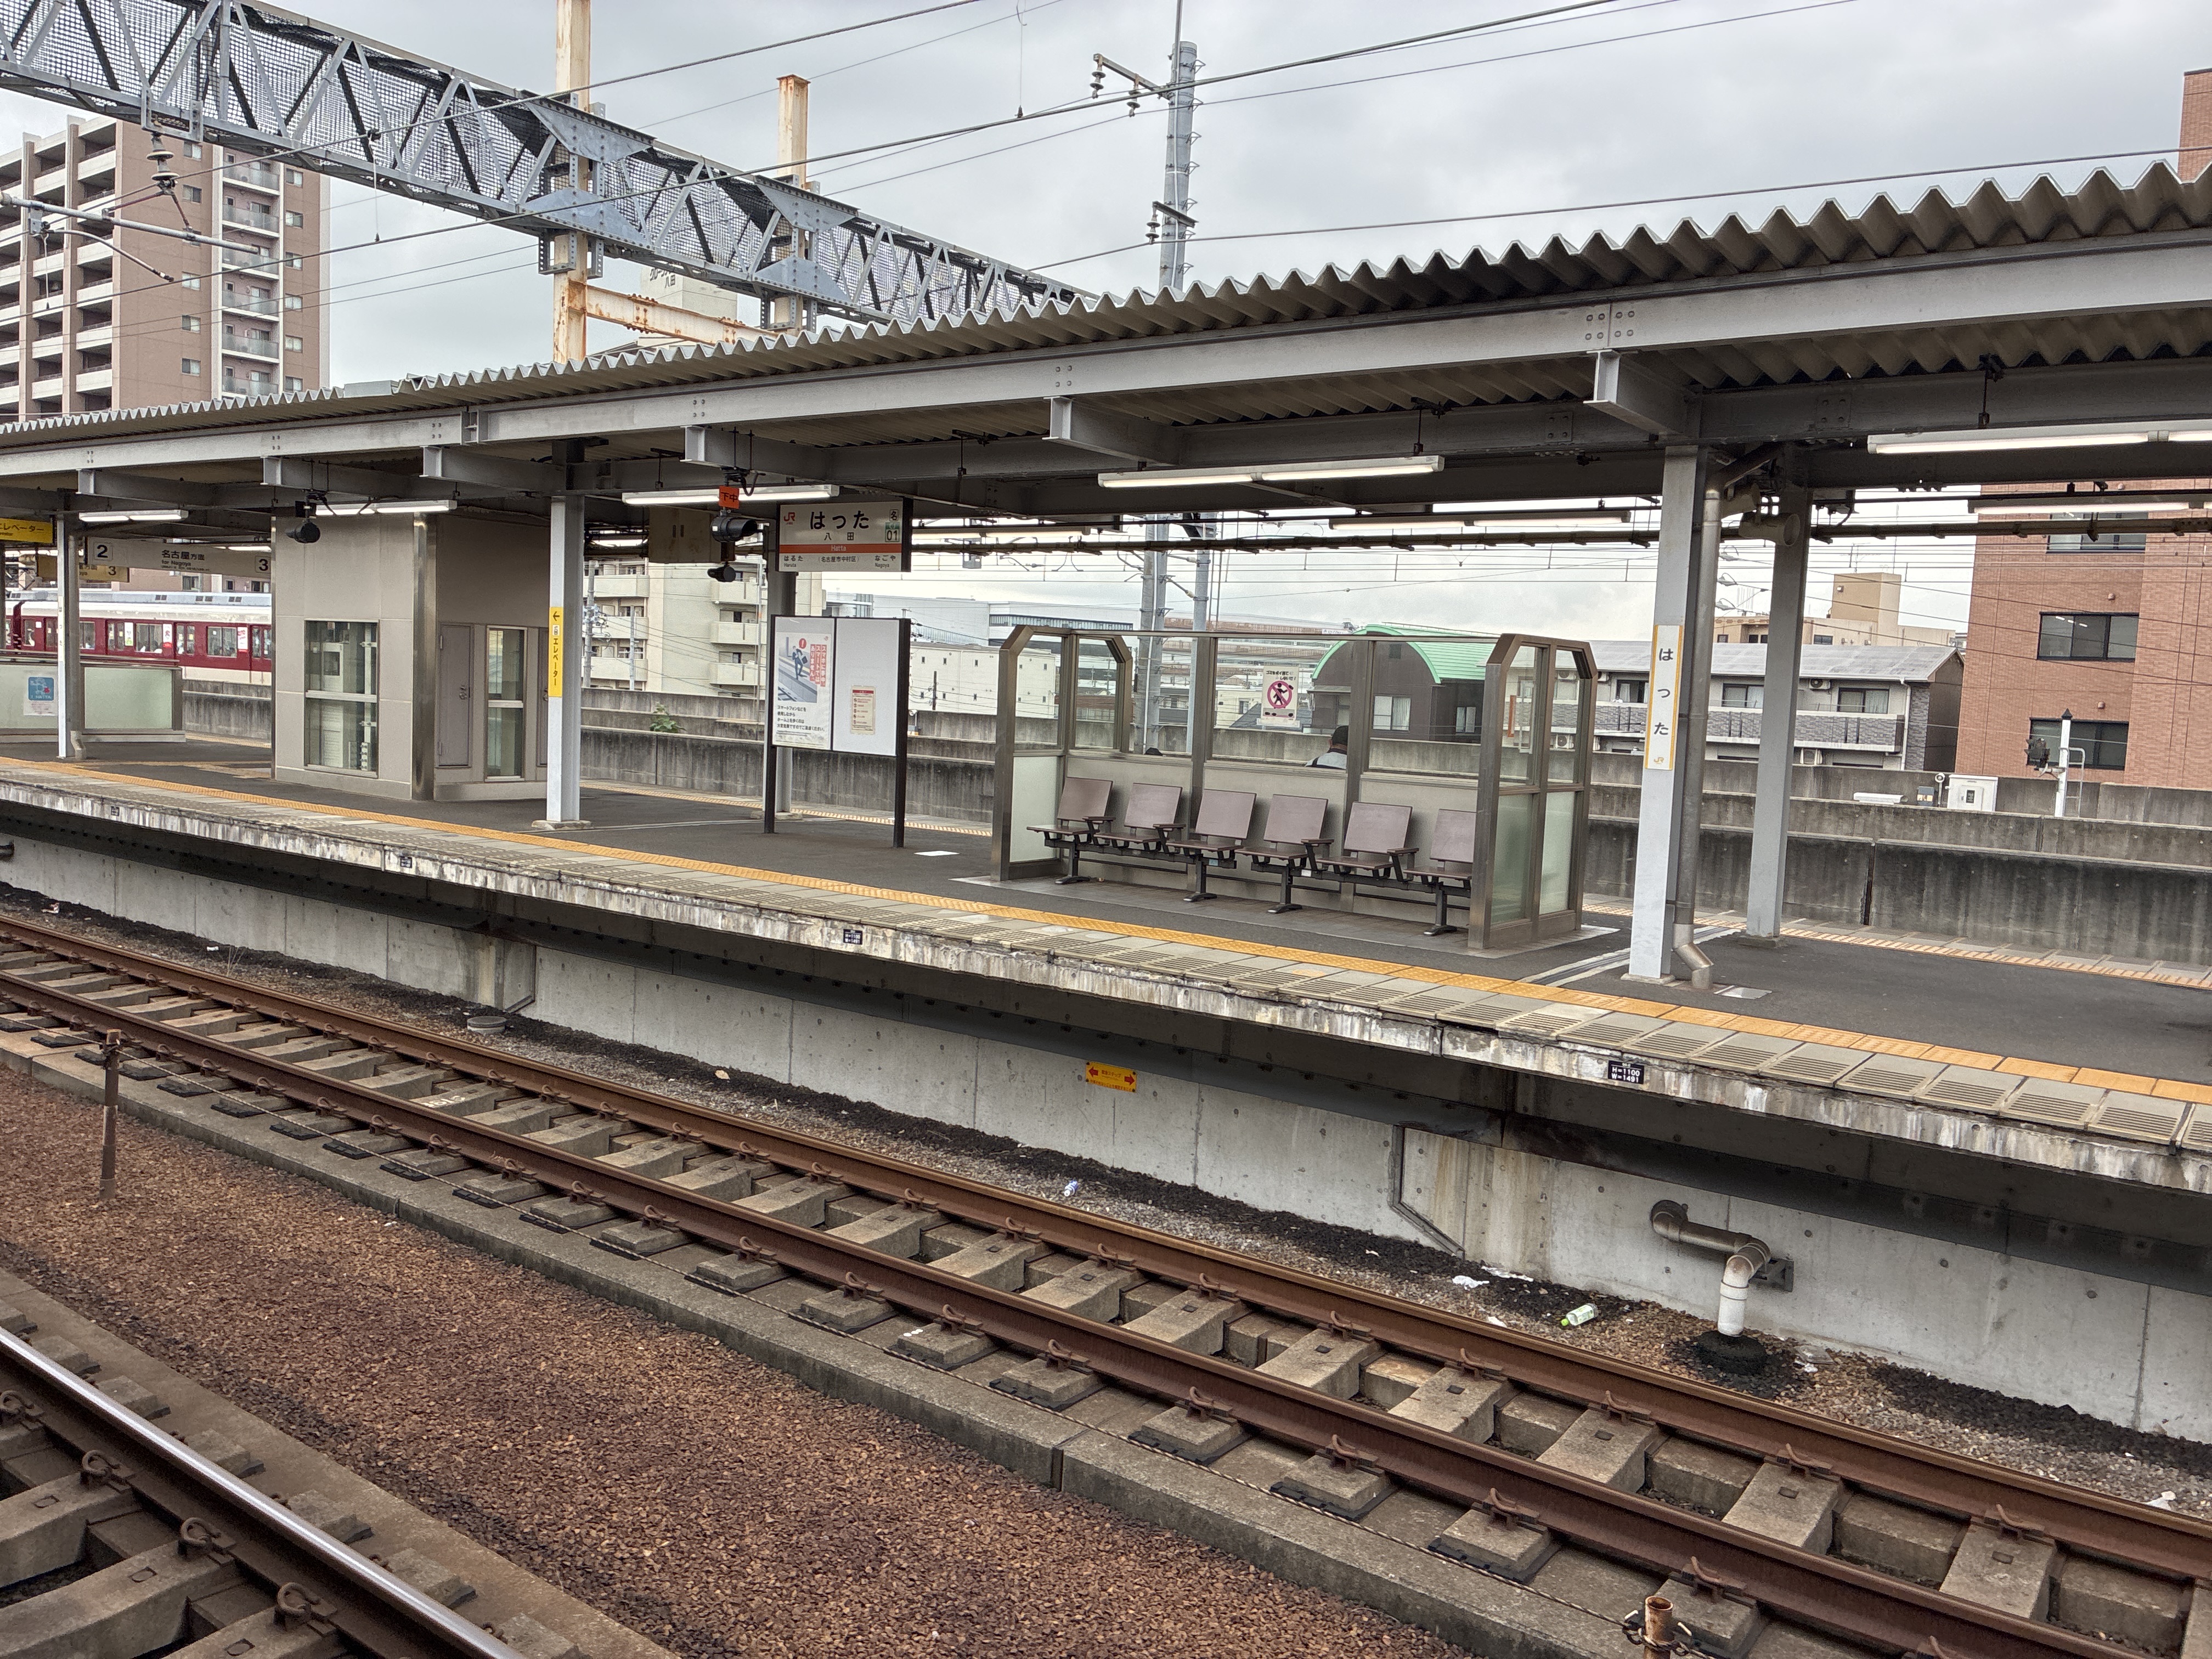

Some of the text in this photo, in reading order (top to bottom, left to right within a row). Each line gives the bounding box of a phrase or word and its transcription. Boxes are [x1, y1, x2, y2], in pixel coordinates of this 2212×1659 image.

[721, 492, 738, 503] 下中
[783, 512, 795, 521] JR
[810, 510, 869, 530] はった
[891, 510, 898, 521] 名
[887, 530, 898, 541] 01
[97, 545, 109, 558] 2
[258, 558, 269, 571] 3
[108, 566, 117, 576] 3
[1654, 648, 1673, 735] はった
[1612, 1066, 1640, 1077] H=1100
[1611, 1073, 1639, 1083] W=1491
